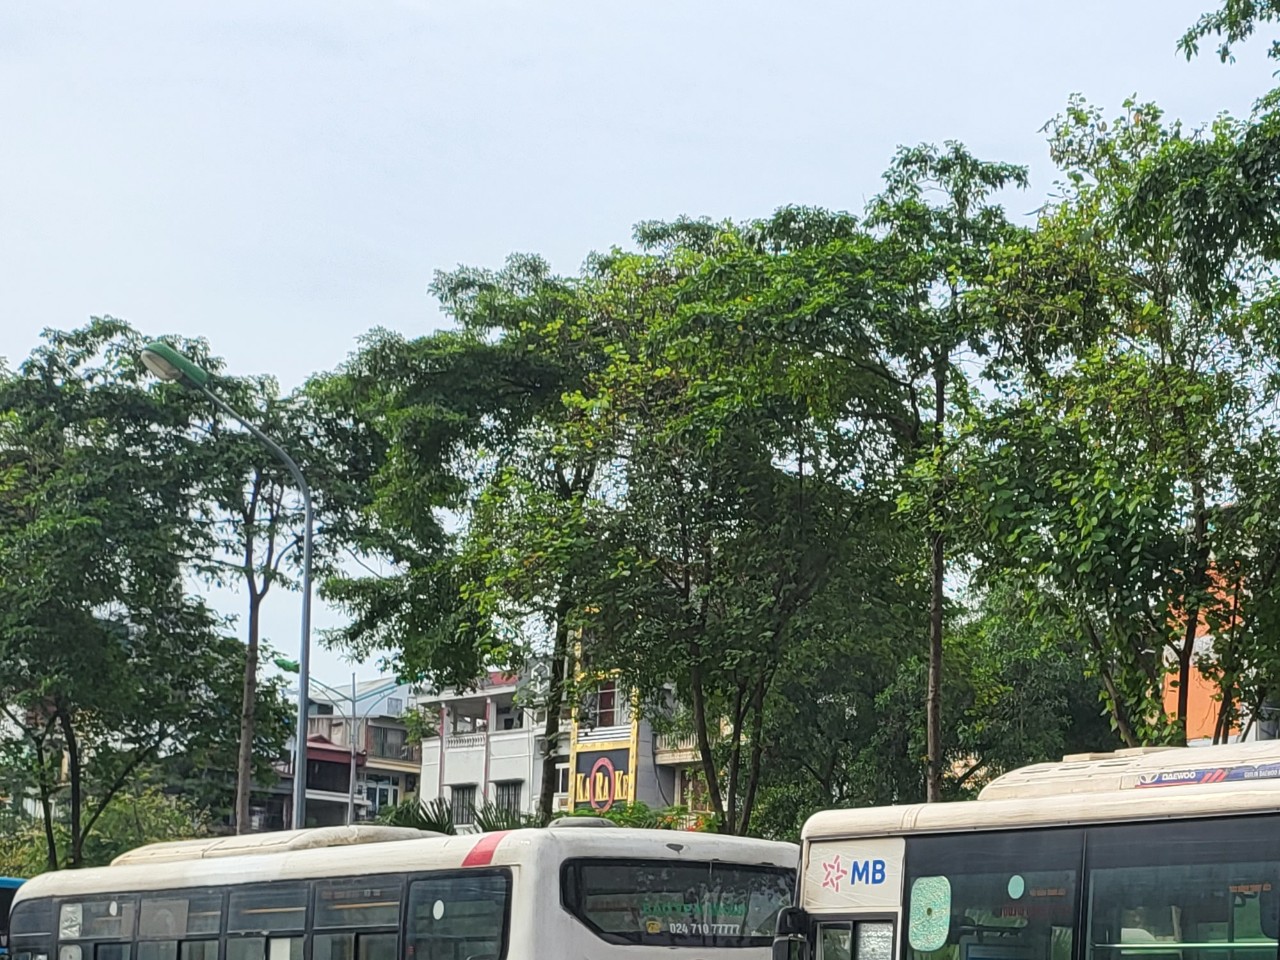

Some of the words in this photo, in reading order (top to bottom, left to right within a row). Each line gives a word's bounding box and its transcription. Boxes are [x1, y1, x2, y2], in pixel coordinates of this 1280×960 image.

[1162, 772, 1196, 781] DAEWOO
[851, 859, 886, 885] MB
[669, 923, 689, 934] 024
[691, 923, 709, 934] 710
[712, 923, 740, 935] 77777
